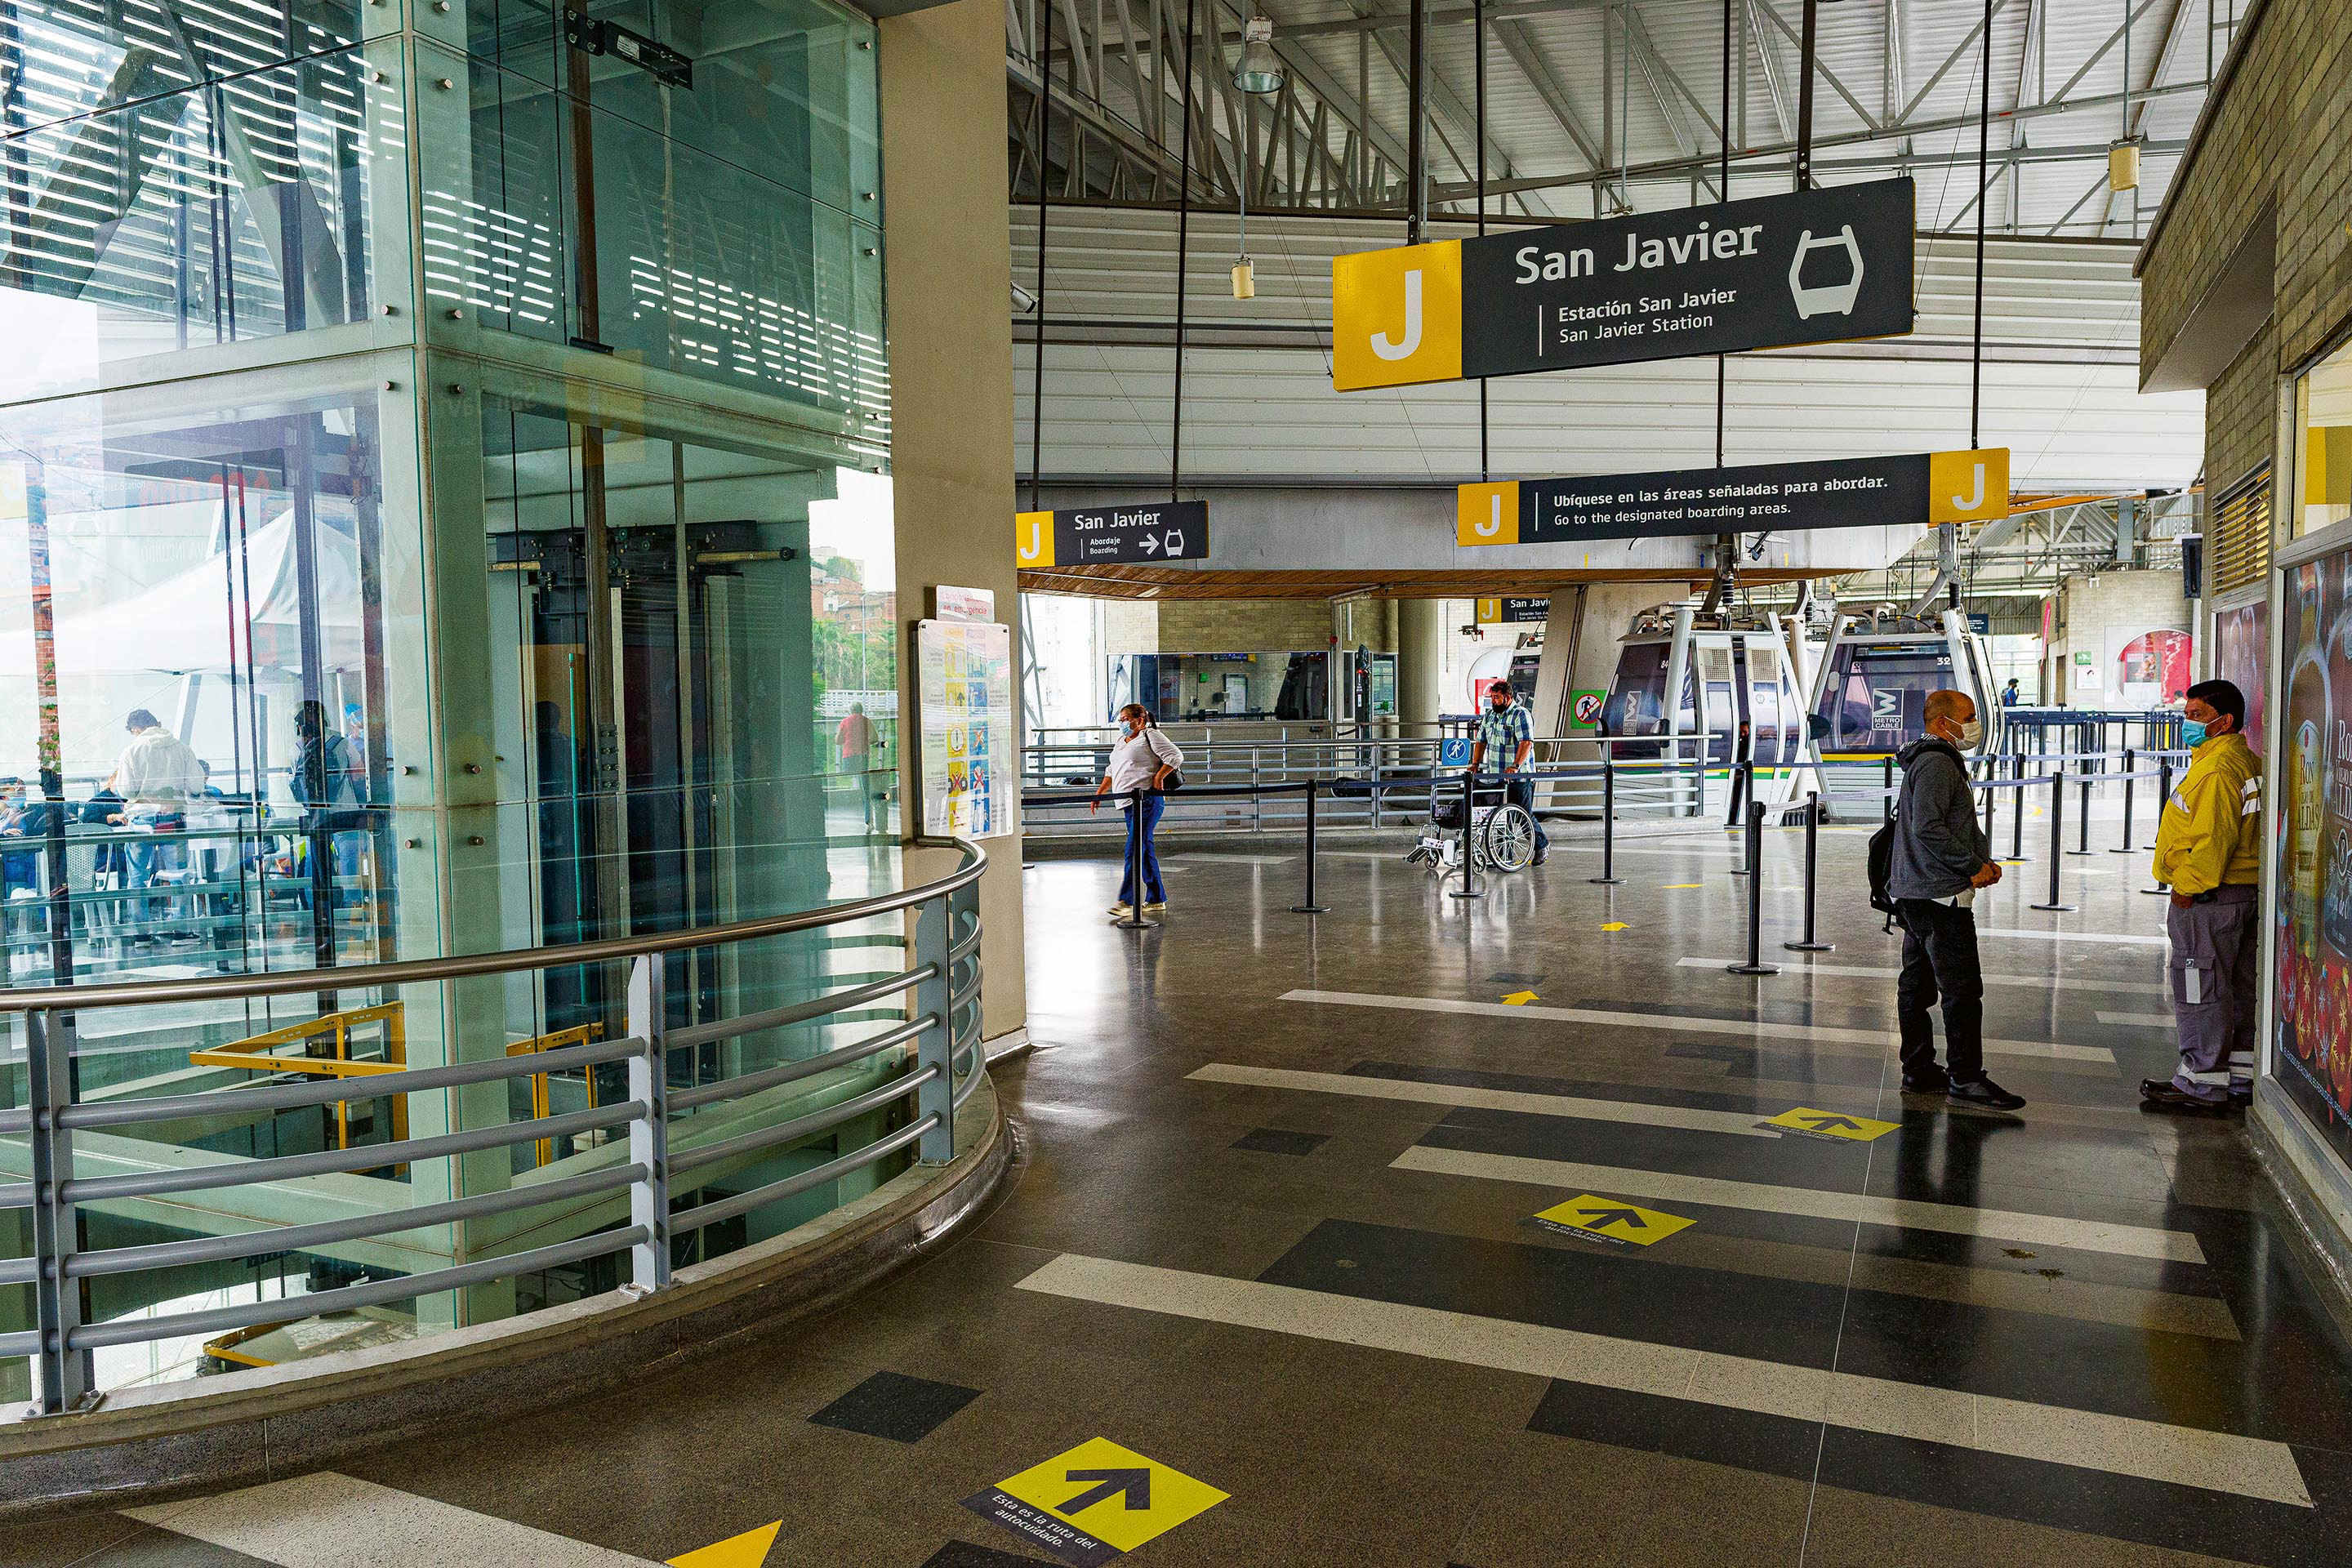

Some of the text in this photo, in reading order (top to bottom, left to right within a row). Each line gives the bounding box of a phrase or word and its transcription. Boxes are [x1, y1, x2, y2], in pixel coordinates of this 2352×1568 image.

[1516, 221, 1762, 285] San Javier
[1370, 270, 1423, 361] J
[1559, 289, 1736, 322] Estación San Javier
[1560, 314, 1713, 343] San Javier Station
[1554, 477, 1888, 508] Ubíquese en las áreas señaladas para abordar.
[1952, 464, 1985, 510] J
[1075, 510, 1160, 530] San Javier
[1475, 495, 1500, 537] J
[1554, 504, 1791, 525] Go to the designated boarding areas.
[1020, 523, 1040, 559] J
[1090, 537, 1120, 546] Abordaje
[1482, 600, 1494, 619] J
[1510, 599, 1527, 608] San
[1661, 660, 1668, 669] 84
[1937, 657, 1951, 666] 32
[1586, 1232, 1607, 1240] ruta
[992, 1494, 1098, 1550] Esta es la ruta del
[995, 1508, 1062, 1548] autocuidado.
